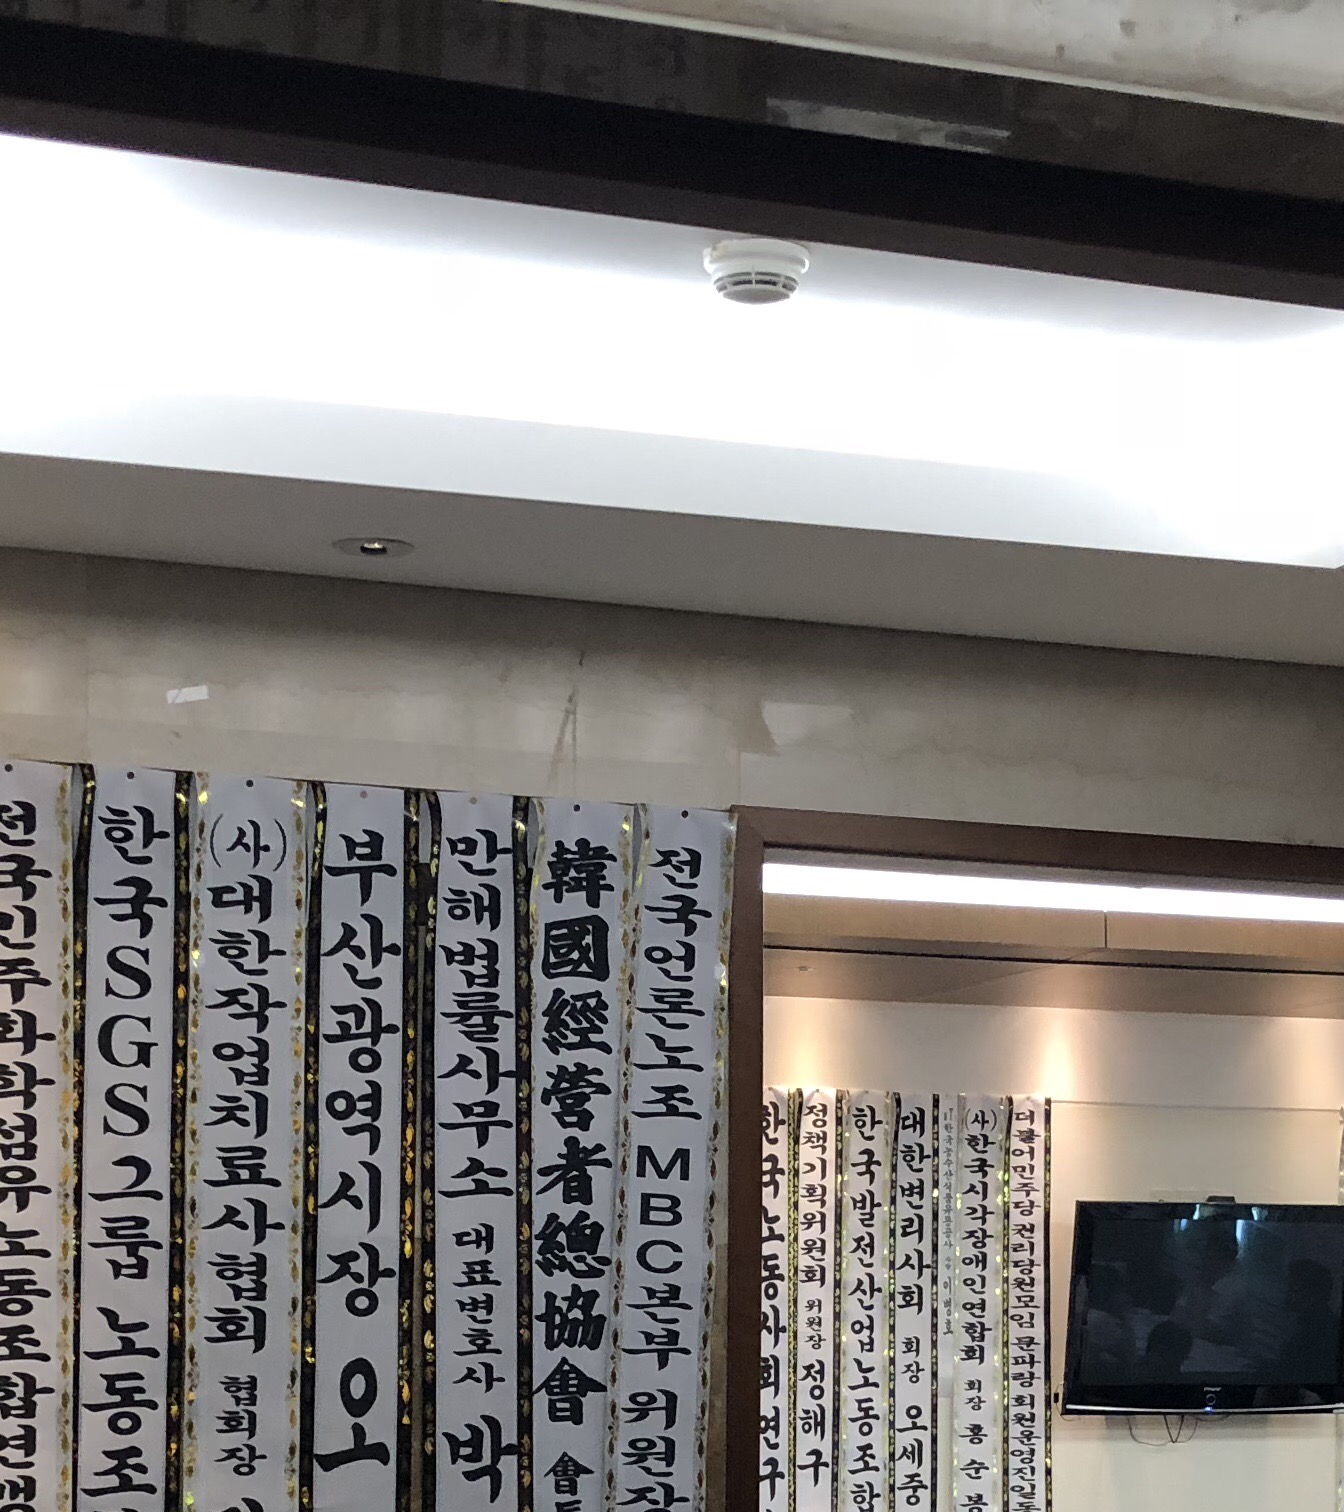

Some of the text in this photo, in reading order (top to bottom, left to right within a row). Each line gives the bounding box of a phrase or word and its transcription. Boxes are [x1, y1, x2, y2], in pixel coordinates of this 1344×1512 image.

[318, 829, 401, 1318] 부산광역시장
[631, 846, 712, 1120] 전국언론노조
[215, 1374, 267, 1477] 협회장
[452, 1223, 506, 1394] 대표변호사
[797, 1103, 829, 1487] 정책기획위원회 위원장 정해구
[895, 1106, 931, 1506] 대한변리사회 회장 오세중
[964, 1379, 987, 1411] 회장
